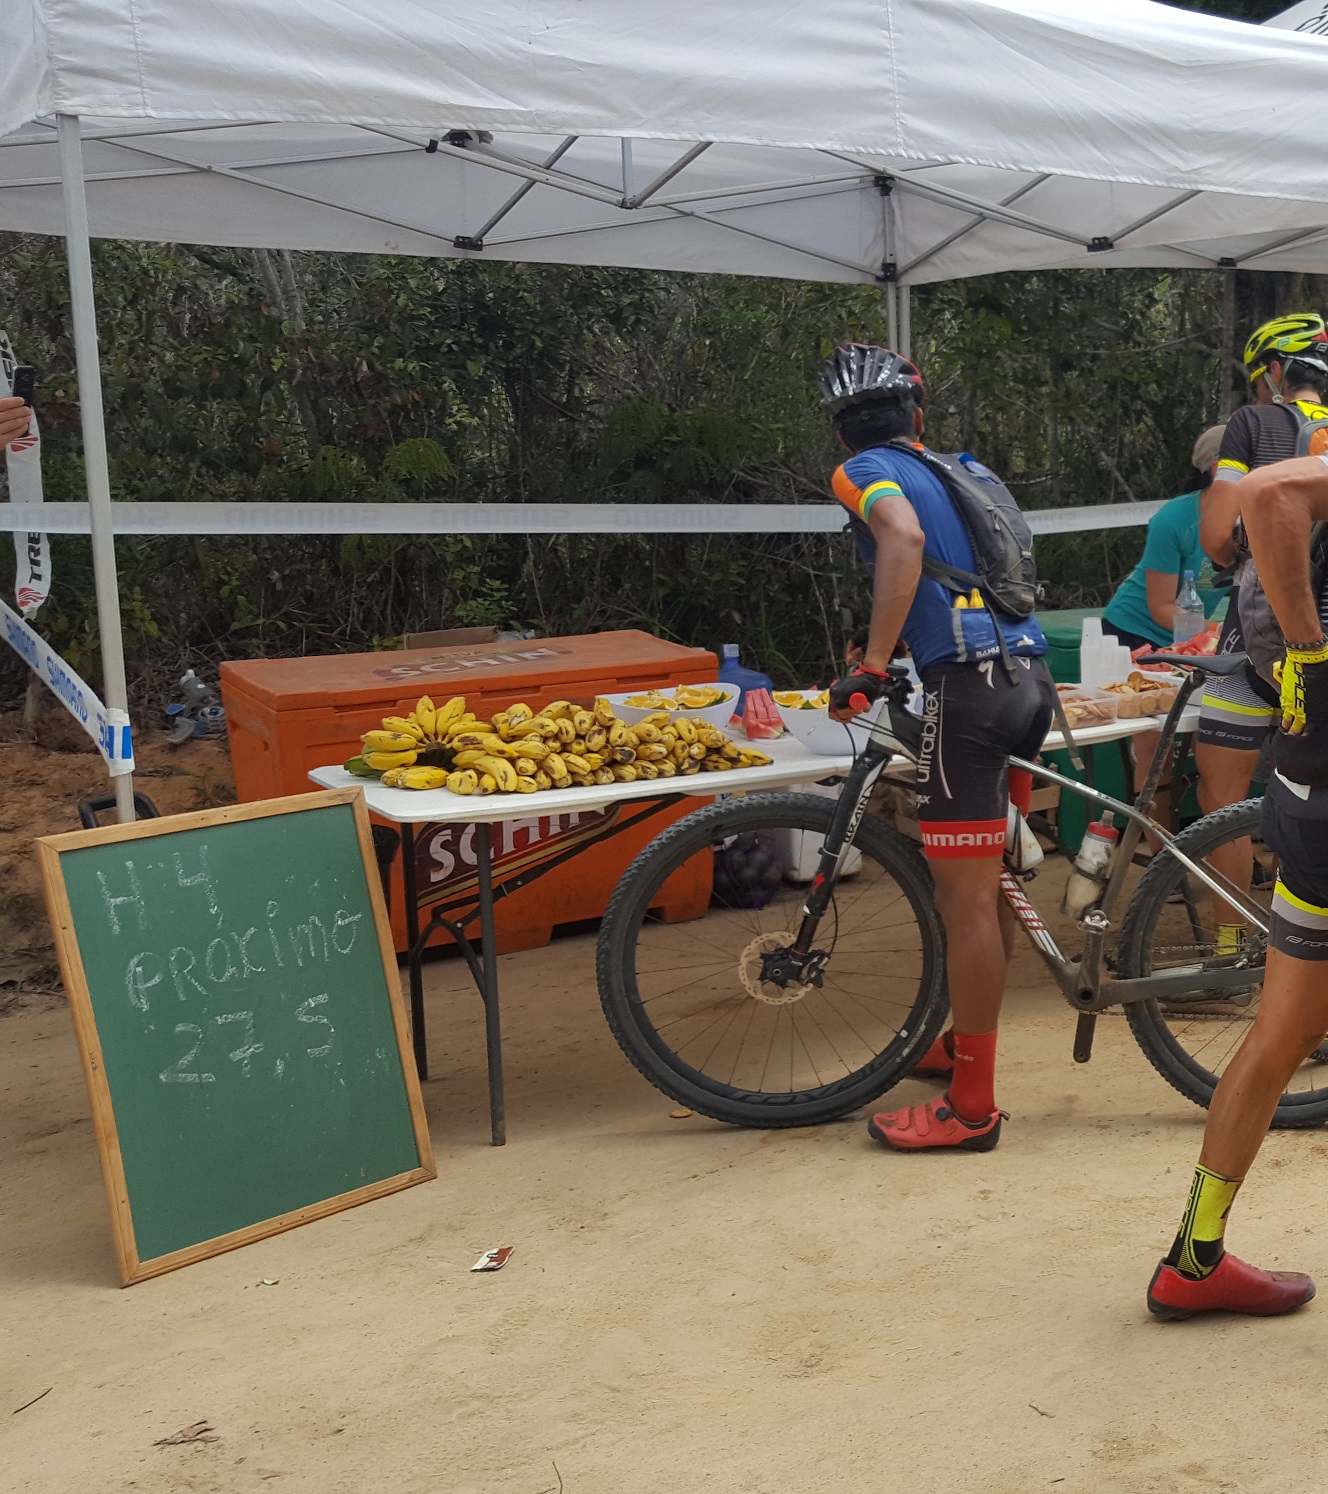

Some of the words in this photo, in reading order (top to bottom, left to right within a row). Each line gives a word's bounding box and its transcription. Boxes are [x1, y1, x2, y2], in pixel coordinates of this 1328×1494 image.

[27, 532, 42, 584] TRE
[390, 647, 558, 678] SCHIN
[923, 833, 1006, 847] IMANO
